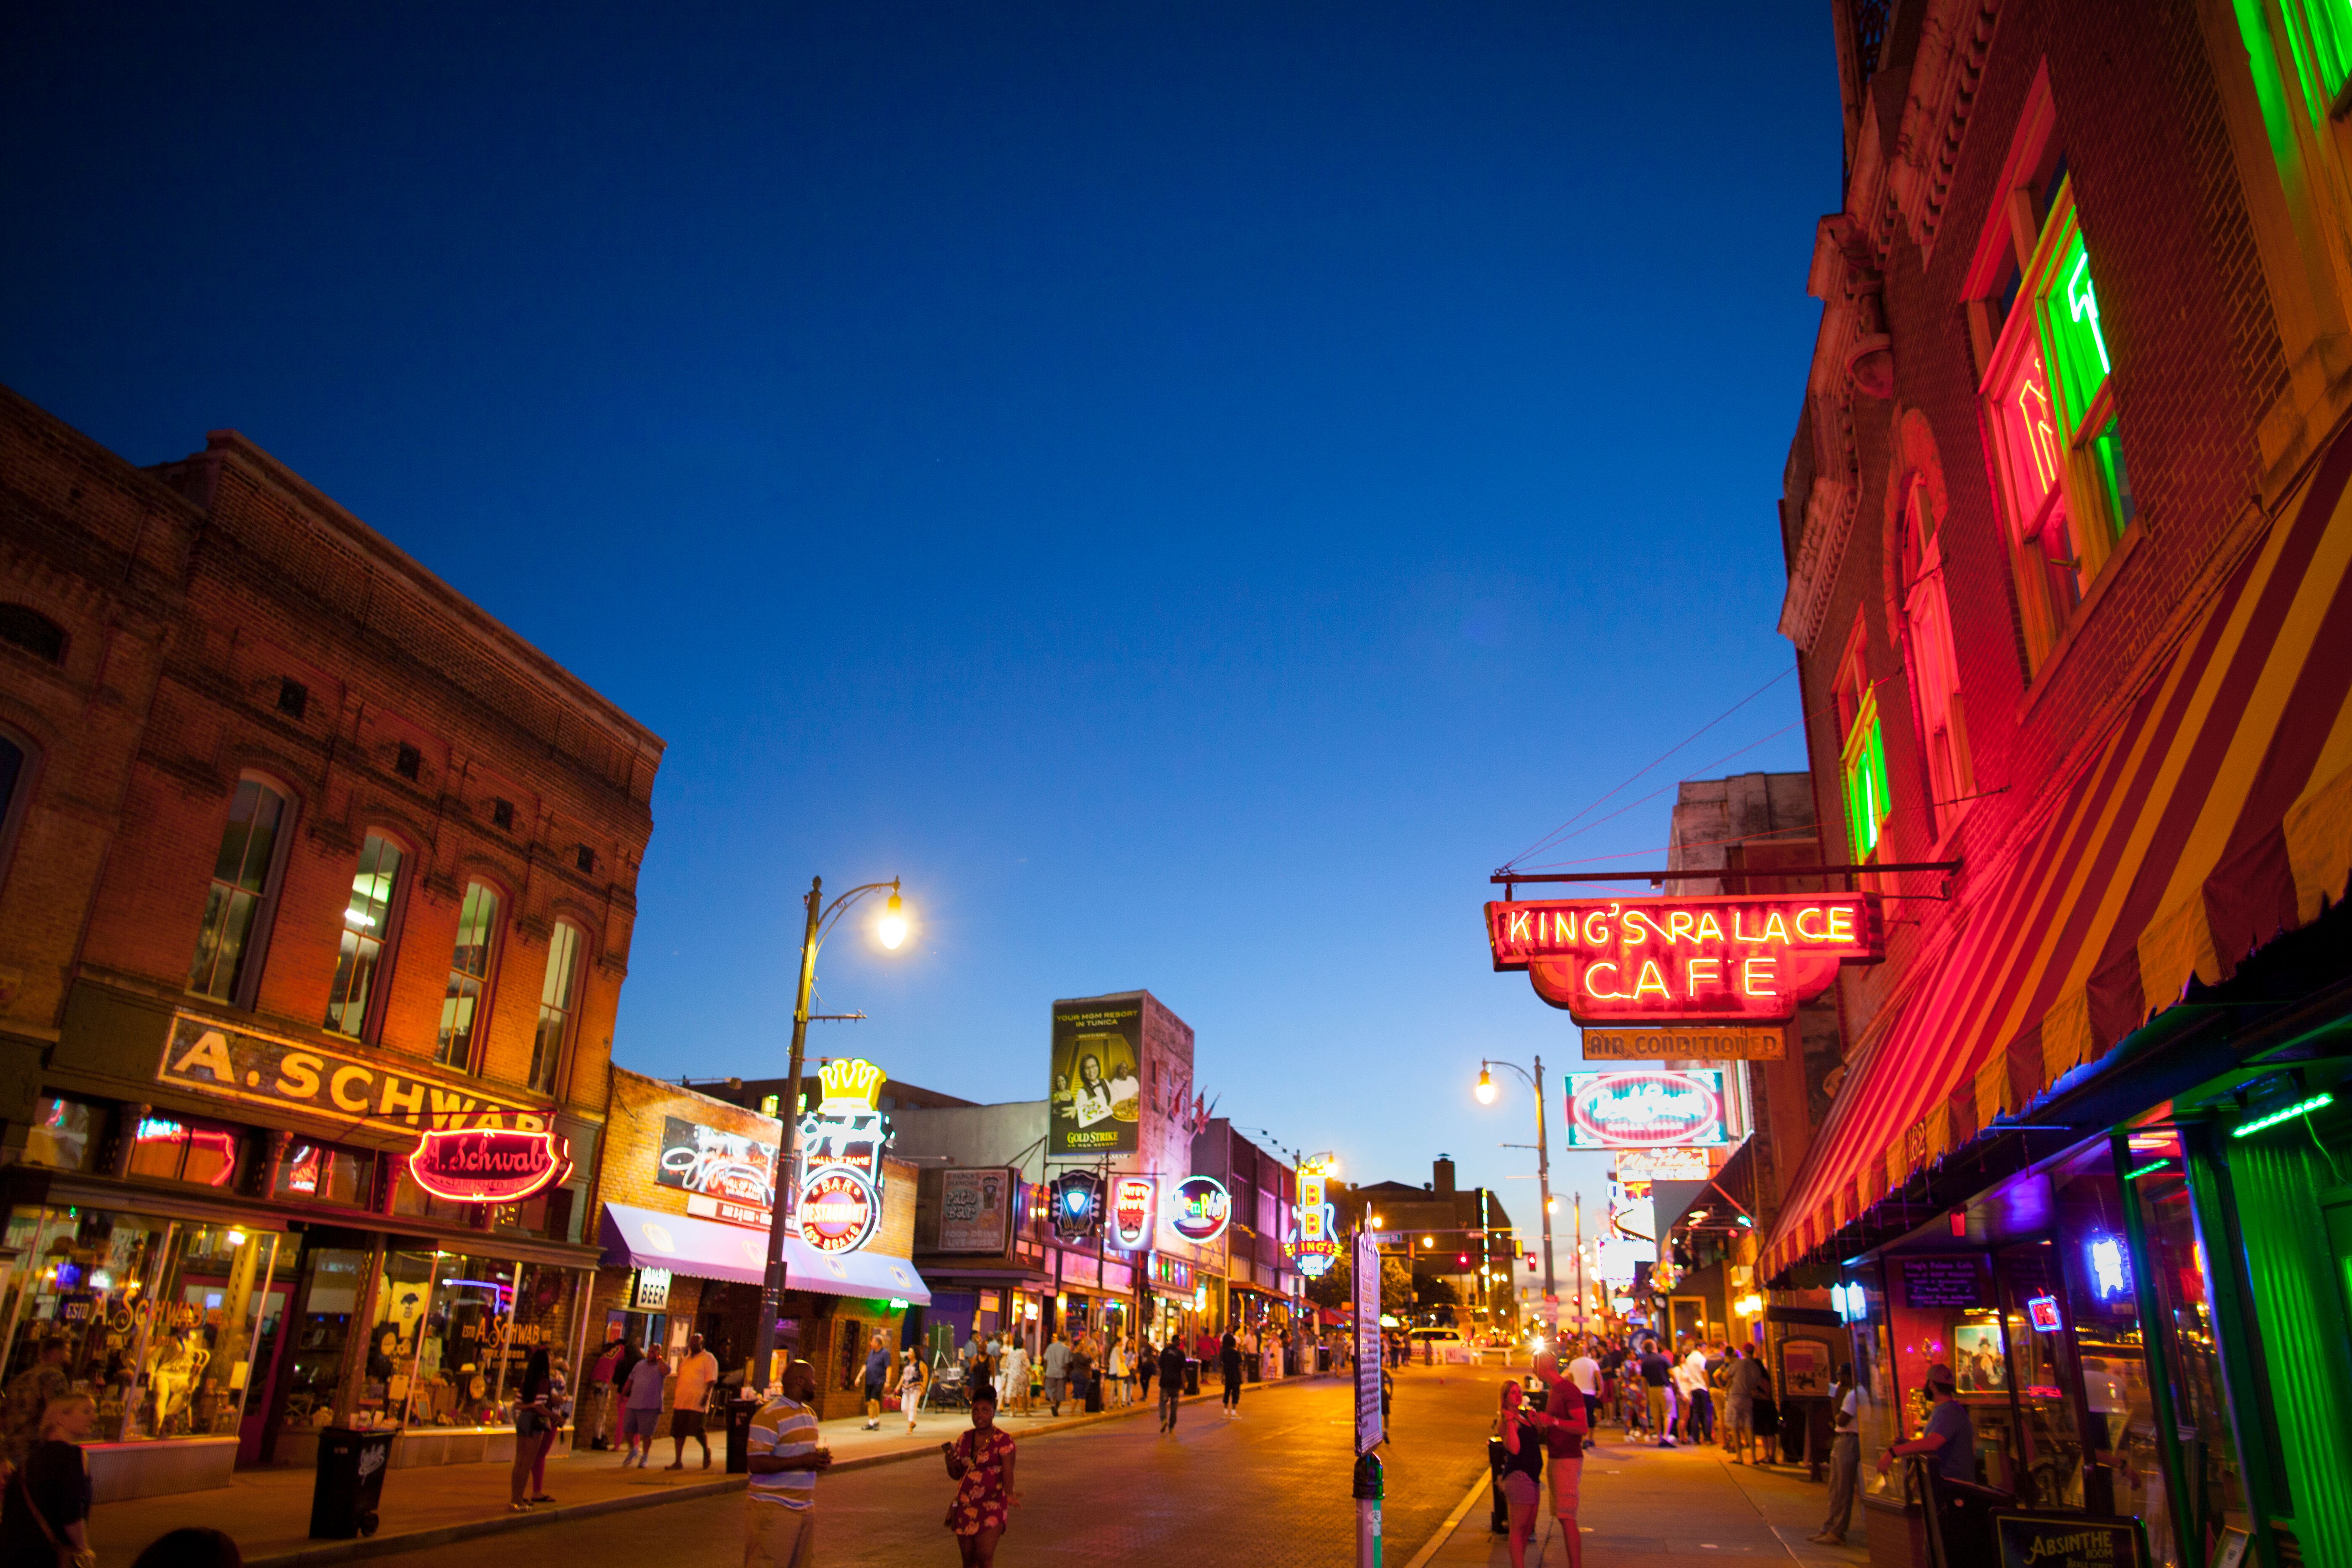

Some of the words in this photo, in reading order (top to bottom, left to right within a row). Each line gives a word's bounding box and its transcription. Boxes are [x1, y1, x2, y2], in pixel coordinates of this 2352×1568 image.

[1509, 903, 1647, 945] KING'S
[1585, 958, 1777, 1000] CAFE
[1104, 1010, 1138, 1018] RESORT
[1591, 1035, 1625, 1055] AIR
[1634, 1035, 1777, 1055] CONDITIONED
[1067, 1132, 1089, 1144] GOLD
[1090, 1131, 1118, 1143] STRIKE
[449, 1137, 548, 1171] Schwab
[821, 1178, 854, 1193] BAR
[802, 1203, 867, 1224] RESTAURANT
[640, 1284, 665, 1305] BEER
[112, 1288, 203, 1333] SCHWAB
[488, 1315, 540, 1349] SCHWAB
[2022, 1530, 2114, 1565] ABSINTHE
[2085, 1548, 2114, 1559] ROOM
